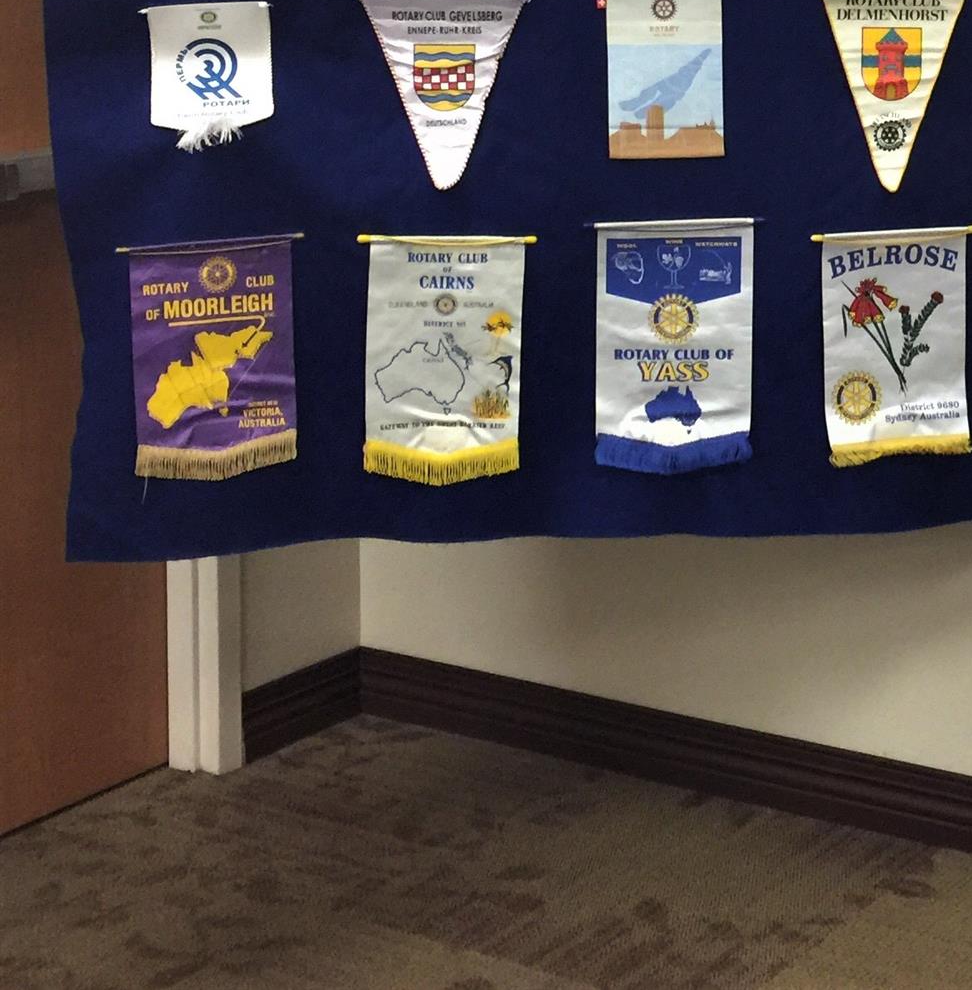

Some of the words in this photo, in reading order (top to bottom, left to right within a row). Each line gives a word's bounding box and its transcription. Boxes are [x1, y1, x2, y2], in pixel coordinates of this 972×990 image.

[392, 11, 424, 21] ROTARY
[425, 11, 446, 21] CLUB
[450, 11, 503, 22] GEVELSBERG
[836, 9, 948, 21] DELMENHORST
[408, 252, 454, 264] ROTARY
[458, 252, 489, 264] CLUB
[827, 244, 959, 279] BELROSE
[142, 282, 189, 296] ROTARY
[246, 274, 275, 287] CLUB
[419, 275, 475, 290] CAIRNS
[146, 309, 161, 321] OF
[163, 292, 274, 319] MOORLEIGH
[614, 349, 668, 360] ROTARY
[674, 349, 710, 360] CLUB
[715, 349, 735, 359] OF
[638, 361, 710, 382] YASS
[238, 418, 285, 428] AUSTRALIA
[885, 413, 918, 424] Sydney
[919, 411, 961, 421] Australia
